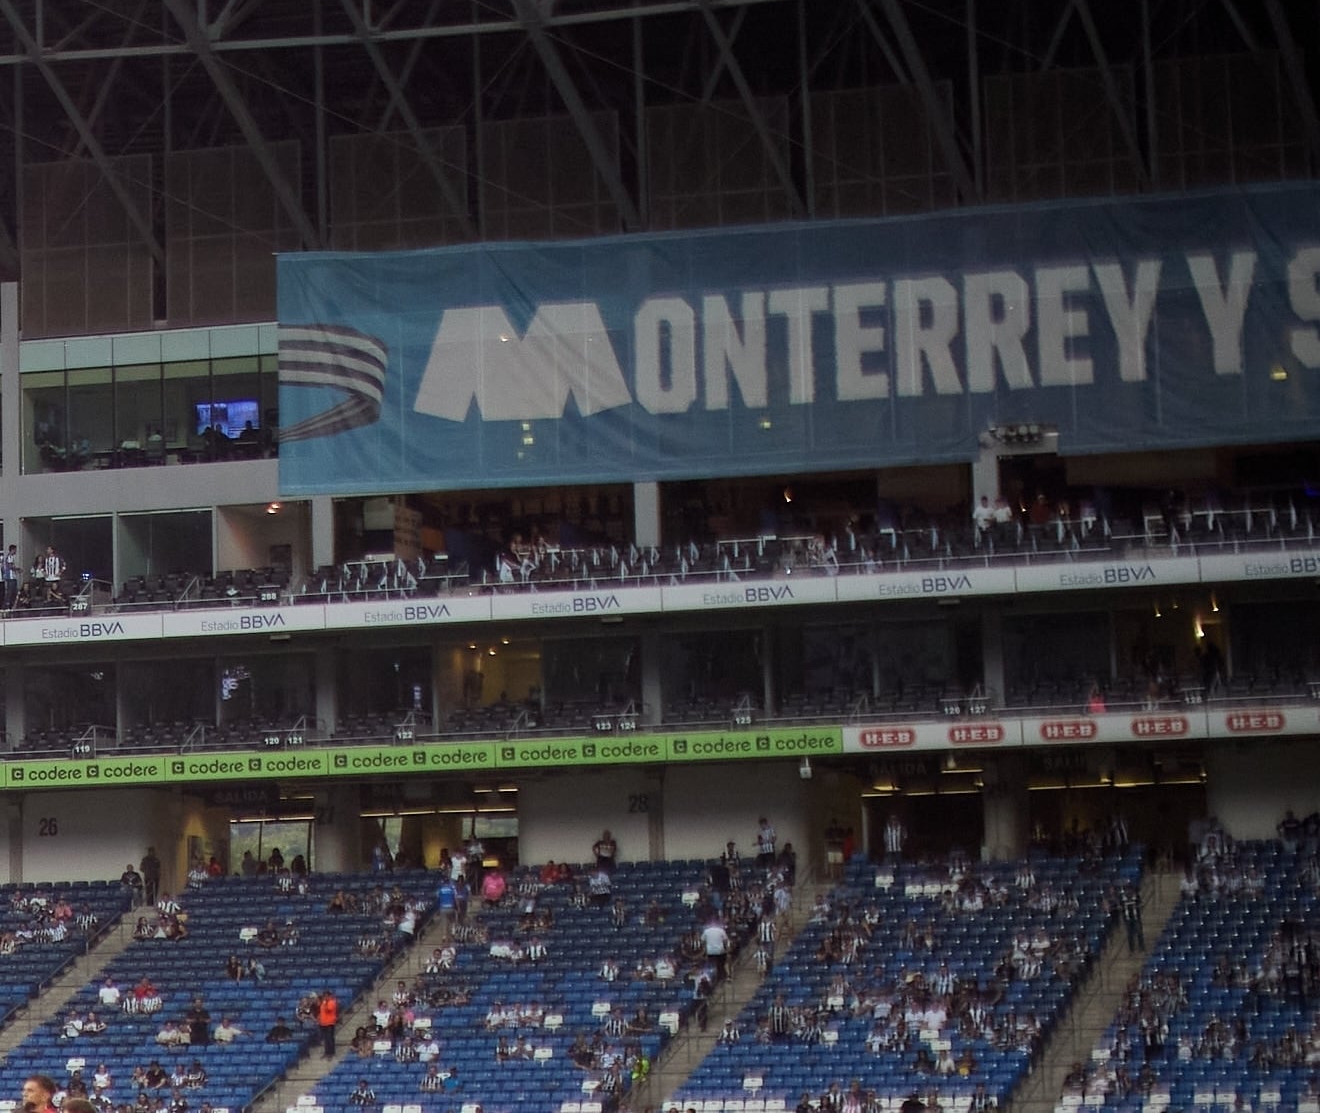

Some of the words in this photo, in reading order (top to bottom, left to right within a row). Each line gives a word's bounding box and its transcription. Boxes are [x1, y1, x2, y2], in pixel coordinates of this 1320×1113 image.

[1187, 252, 1257, 374] Y
[1104, 566, 1156, 584] BBVA
[922, 577, 972, 593] BBVA
[745, 586, 794, 603] BBVA
[363, 609, 404, 622] Estadio
[404, 604, 451, 620] BBVA
[532, 602, 571, 615] Estadio
[573, 596, 620, 612] BBVA
[41, 627, 79, 639] Estadio
[80, 622, 124, 637] BBVA
[200, 619, 239, 632] Estadio
[240, 614, 286, 629] BBVA
[602, 743, 659, 758] codere
[692, 738, 751, 754] codere
[775, 735, 835, 750] codere
[351, 754, 409, 768] codere
[431, 751, 487, 766] codere
[520, 746, 577, 761] codere
[104, 764, 158, 778] codere
[189, 761, 243, 775] codere
[266, 758, 322, 771] codere
[27, 767, 80, 781] codere
[39, 818, 58, 836] 26
